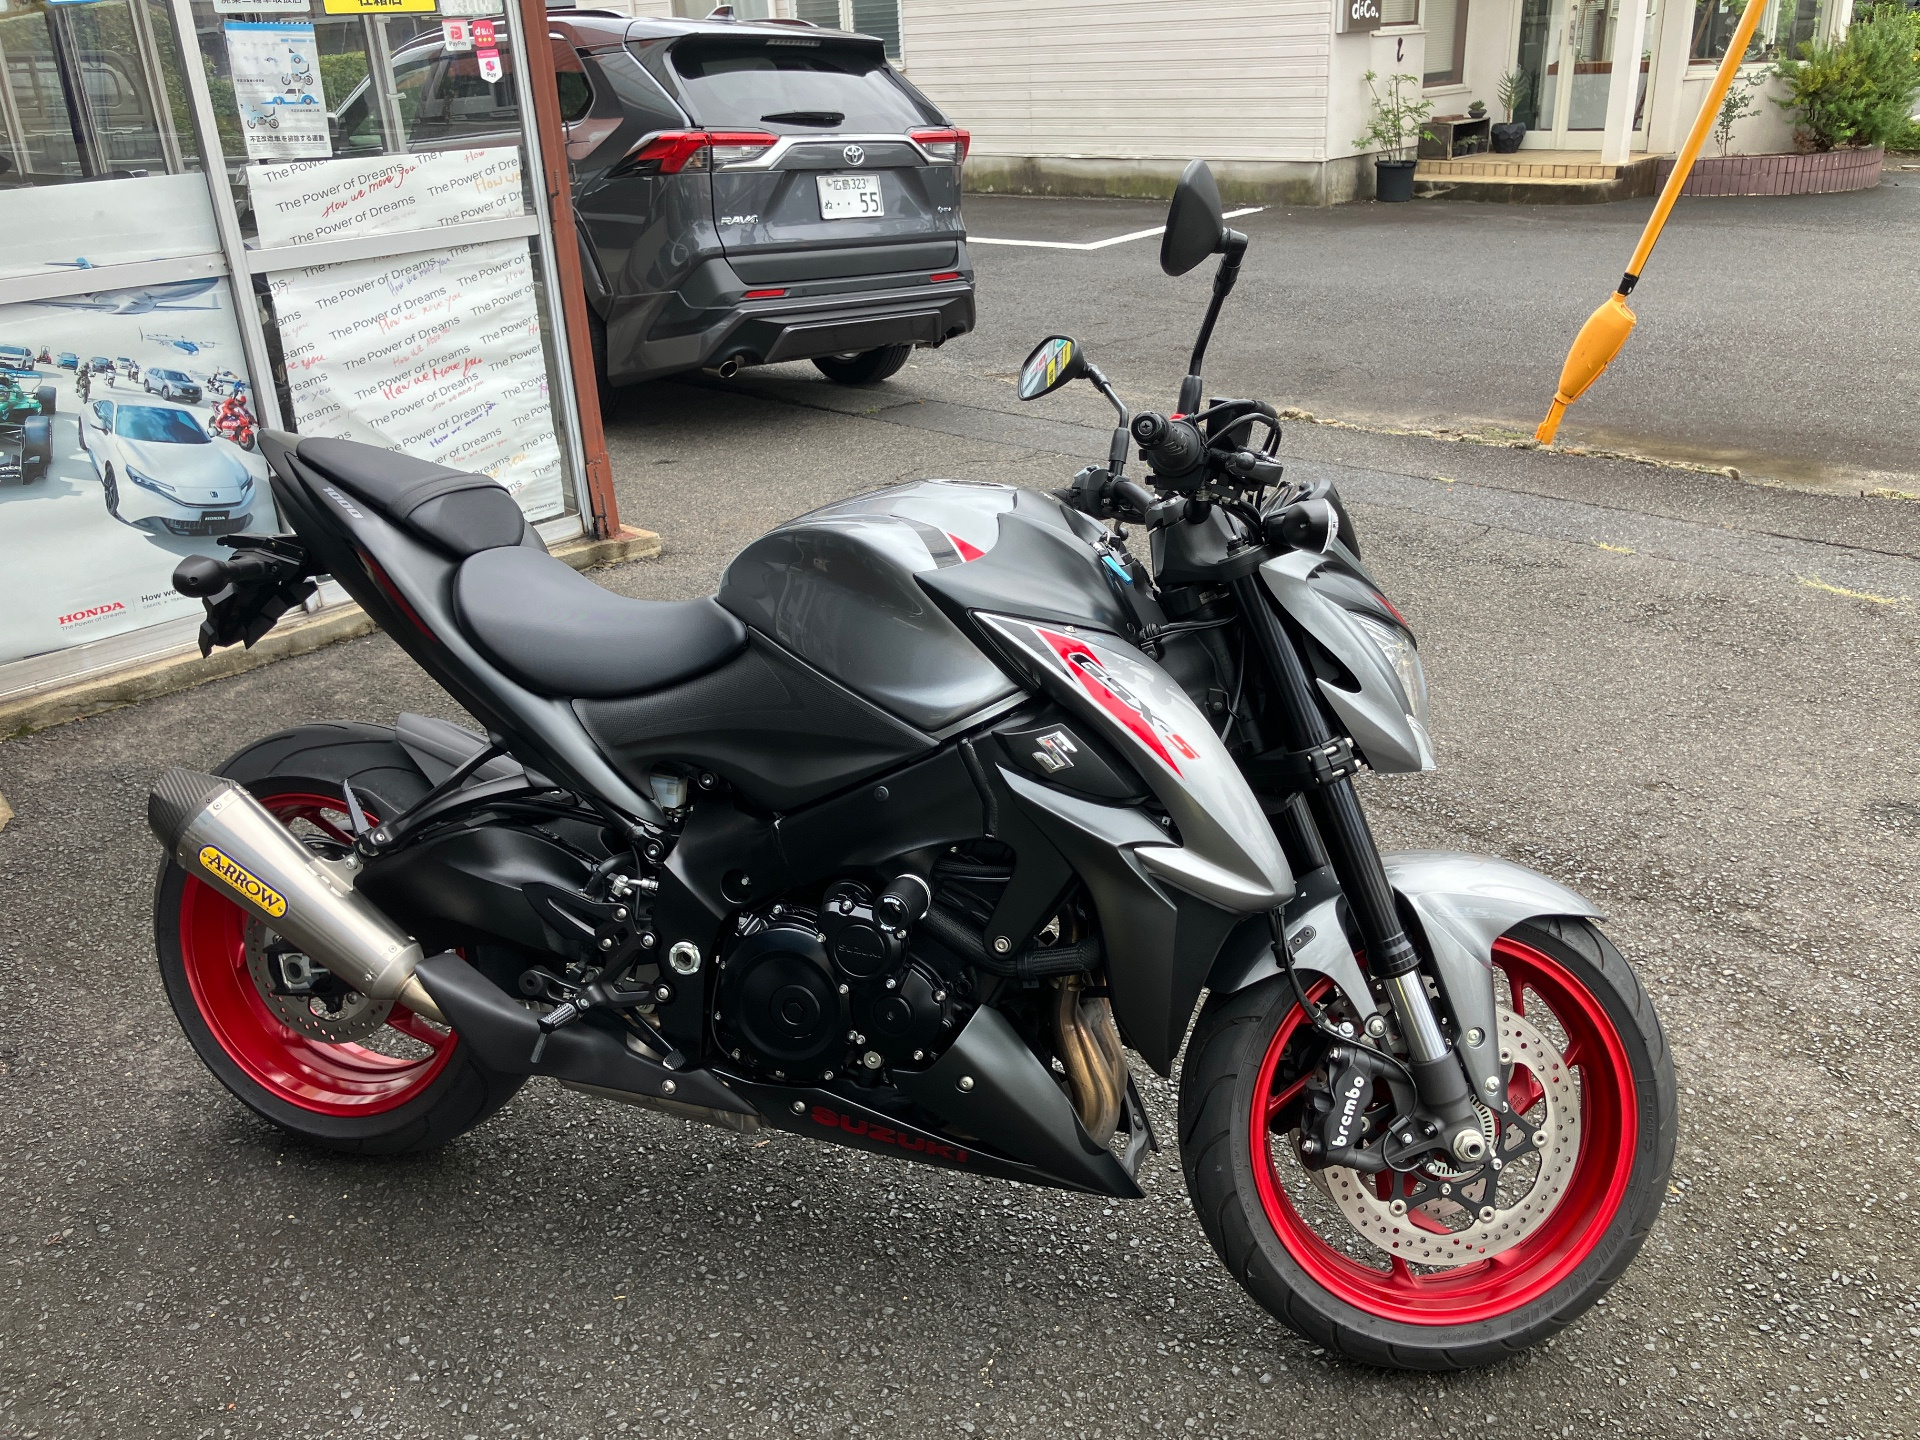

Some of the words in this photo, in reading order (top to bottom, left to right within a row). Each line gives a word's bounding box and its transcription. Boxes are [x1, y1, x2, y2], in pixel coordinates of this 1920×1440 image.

[263, 168, 289, 182] The
[290, 160, 328, 174] Powe
[415, 151, 437, 165] The
[464, 150, 485, 163] How
[275, 199, 302, 213] The
[302, 184, 341, 204] Power
[343, 178, 356, 190] of
[358, 163, 404, 185] Dreams
[427, 184, 449, 197] The
[450, 171, 483, 189] Power
[484, 165, 496, 176] of
[289, 231, 314, 246] The
[315, 217, 353, 237] Power
[355, 210, 367, 222] of
[369, 195, 416, 217] Dreams
[438, 214, 460, 227] The
[460, 200, 494, 220] Power
[496, 195, 507, 207] of
[508, 190, 522, 202] Dr
[721, 214, 758, 225] RAV4
[825, 200, 833, 210] ぬ
[447, 245, 470, 258] The
[301, 264, 326, 278] The
[315, 295, 339, 310] The
[339, 280, 375, 300] Power
[377, 273, 389, 285] of
[391, 258, 437, 280] Dreams
[457, 273, 478, 287] The
[479, 260, 512, 278] Power
[514, 253, 525, 265] of
[329, 326, 353, 341] The
[353, 311, 389, 331] Power
[390, 304, 403, 315] of
[404, 287, 447, 310] Dreams
[470, 302, 491, 316] The
[491, 288, 523, 308] Power
[342, 357, 367, 371] The
[367, 341, 402, 361] Power
[405, 334, 417, 346] of
[418, 316, 461, 340] Dreams
[480, 330, 501, 345] The
[500, 317, 532, 336] Power
[354, 386, 377, 400] The
[377, 369, 412, 390] Power
[414, 362, 427, 374] of
[428, 345, 471, 368] Dreams
[488, 357, 510, 372] The
[510, 343, 541, 363] Power
[367, 414, 391, 429] The
[390, 398, 425, 419] Power
[426, 391, 438, 403] of
[438, 372, 479, 396] Dreams
[501, 384, 523, 399] The
[402, 426, 436, 448] Power
[438, 418, 450, 430] of
[451, 400, 492, 425] Dreams
[429, 433, 449, 448] How
[451, 426, 462, 435] we
[465, 413, 483, 427] move
[511, 413, 530, 427] The
[449, 446, 461, 459] of
[461, 427, 502, 452] Dreams
[520, 438, 539, 452] The
[531, 464, 552, 478] The
[322, 487, 364, 519] 1000
[141, 592, 162, 602] How
[163, 588, 177, 597] we
[58, 601, 125, 625] HONDA
[61, 624, 74, 632] The
[74, 618, 94, 628] Power
[102, 610, 127, 620] Dreams
[1068, 652, 1201, 760] GSX-S
[207, 854, 281, 907] ARROW
[1331, 1076, 1365, 1147] brembo
[812, 1106, 968, 1163] SUZUKI
[1510, 1222, 1625, 1332] MICHELIN
